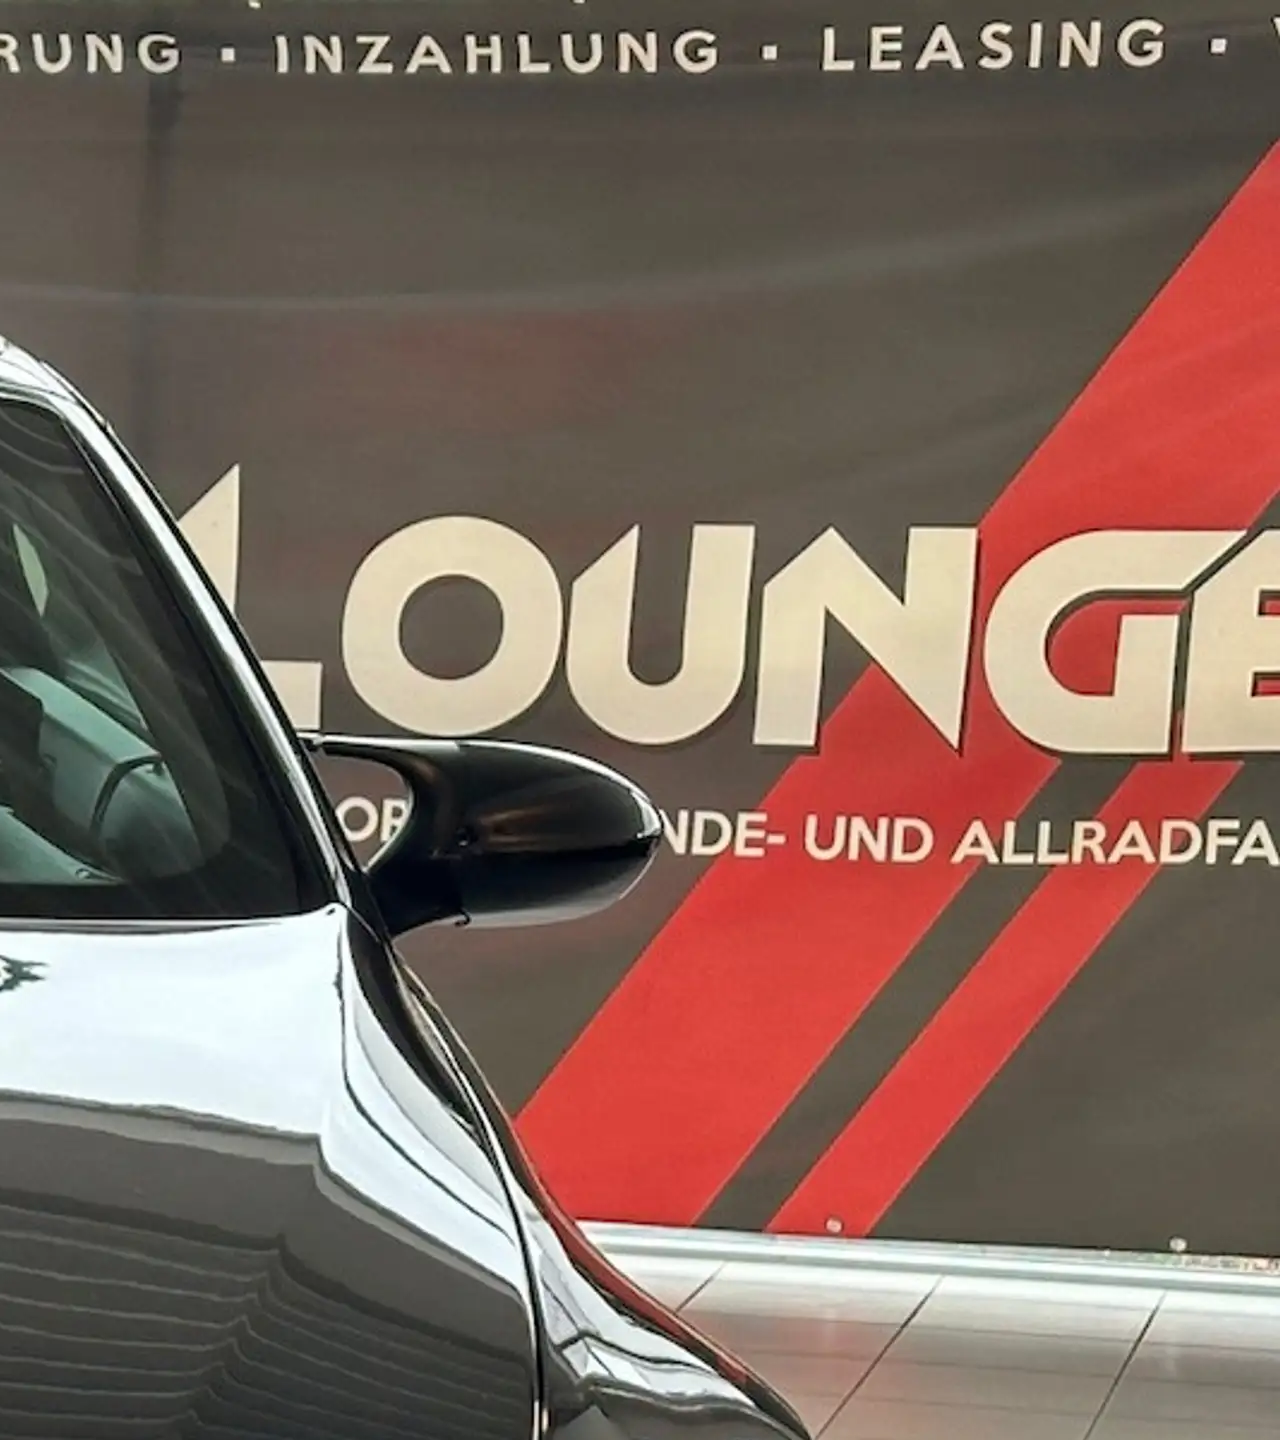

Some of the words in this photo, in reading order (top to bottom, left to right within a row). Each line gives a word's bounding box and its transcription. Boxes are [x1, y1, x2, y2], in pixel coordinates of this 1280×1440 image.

[275, 30, 719, 75] INZAHLUNG
[822, 18, 1165, 72] LEASING
[804, 813, 935, 863] UND
[950, 818, 1280, 868] ALLRADFA
